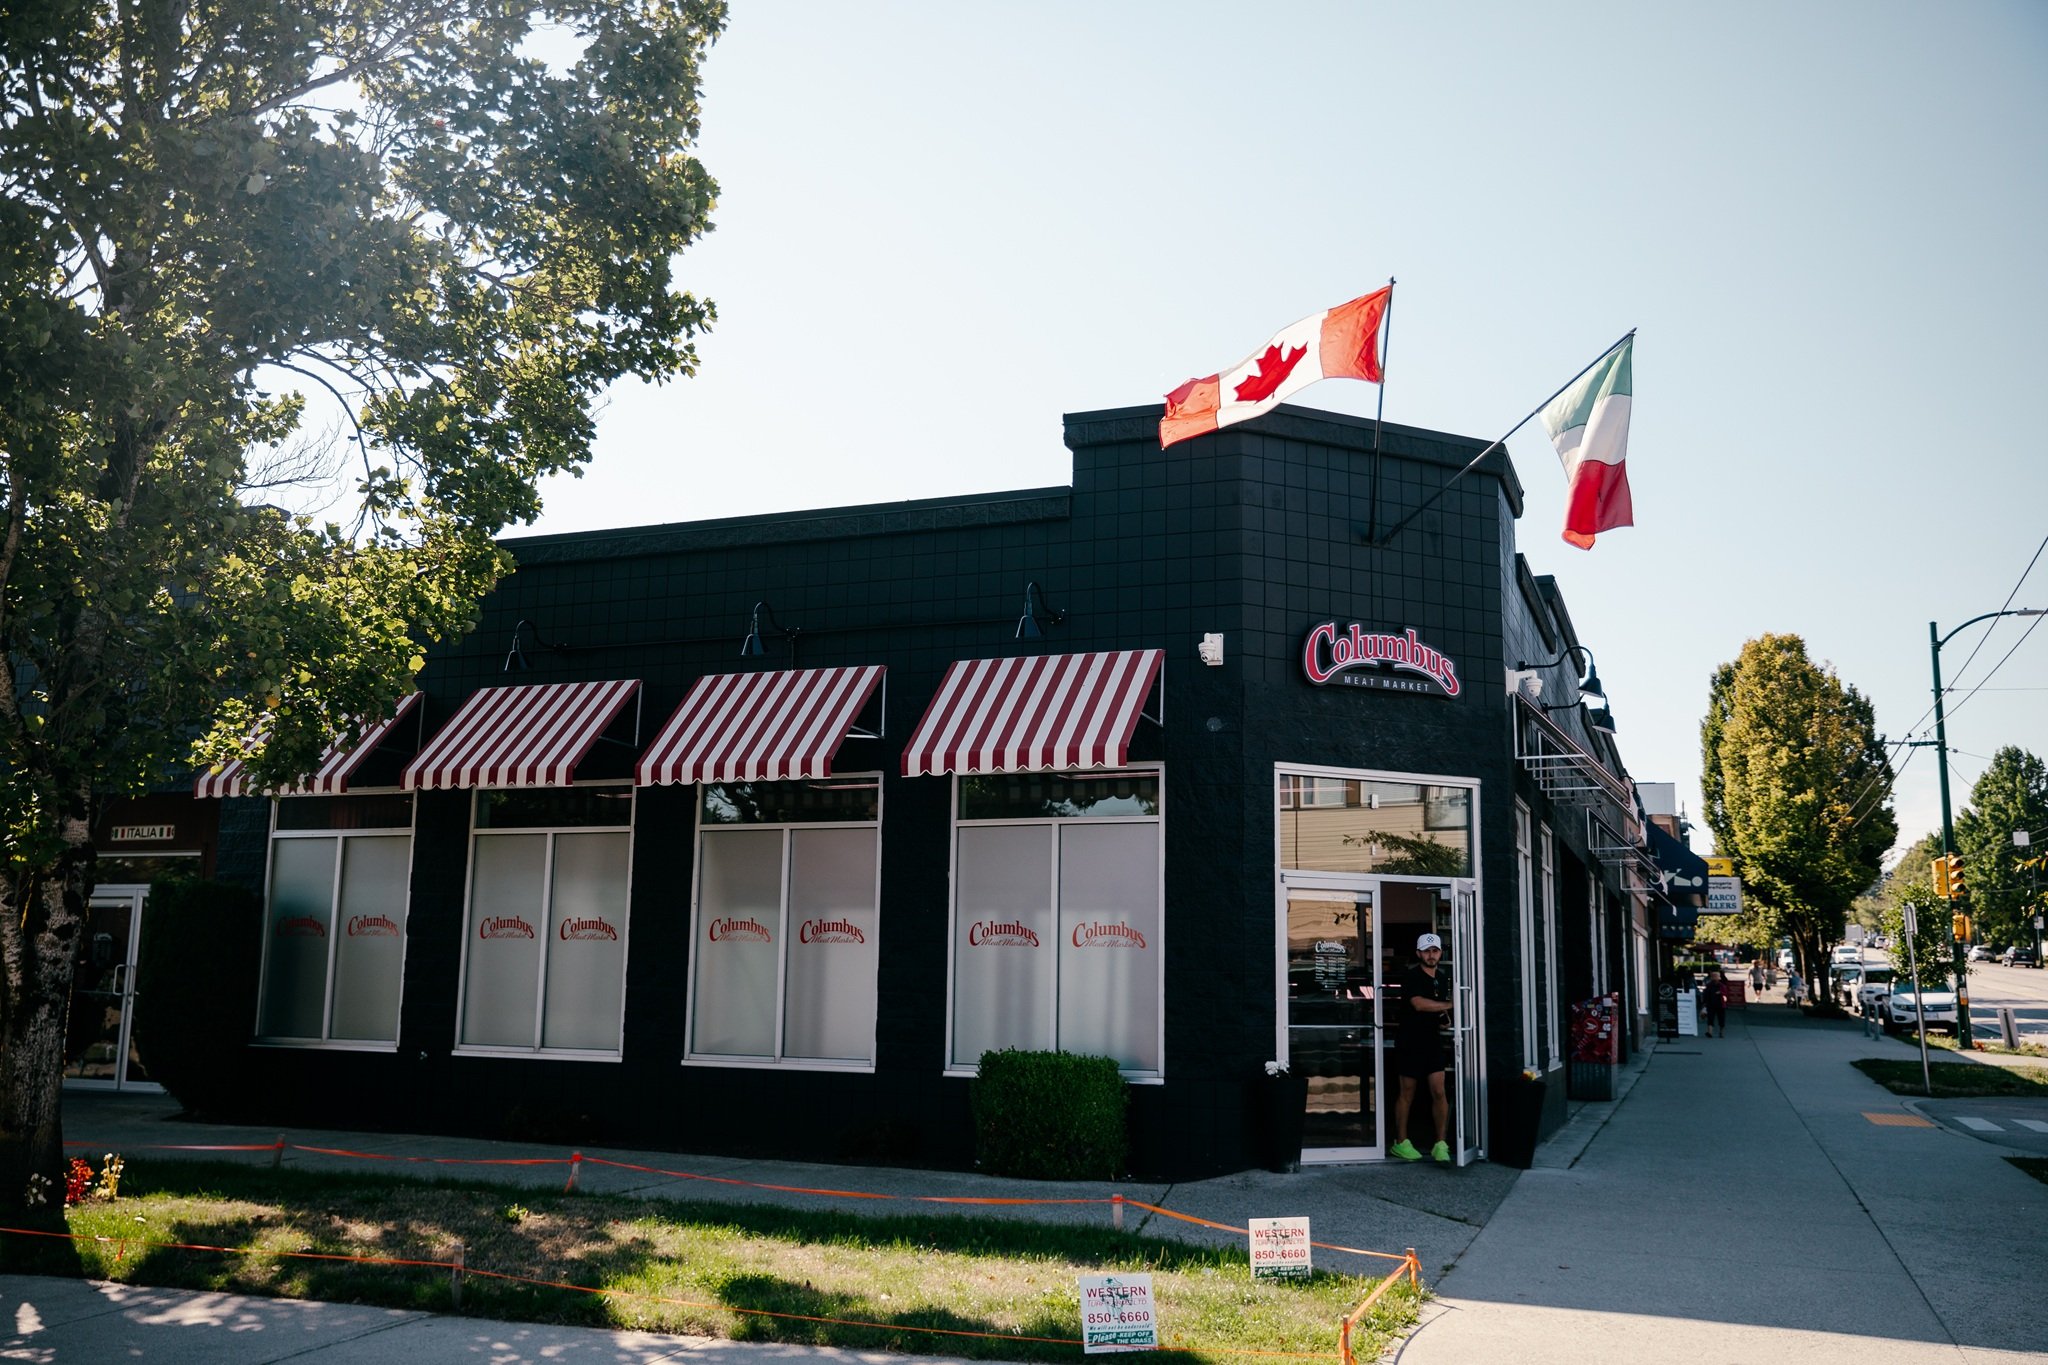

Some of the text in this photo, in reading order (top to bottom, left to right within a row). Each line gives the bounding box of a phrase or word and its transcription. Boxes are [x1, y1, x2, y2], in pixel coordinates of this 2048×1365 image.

[1305, 622, 1460, 696] Columbus
[1344, 675, 1429, 692] MEAT MARKET
[127, 827, 156, 838] ITALIA
[348, 914, 399, 937] Columbus
[480, 915, 535, 940] Columbus
[560, 916, 617, 941] Columbus
[709, 917, 771, 943] Columbus
[799, 918, 865, 944] Columbus
[969, 920, 1040, 948] Columbus
[980, 938, 1030, 947] Meat Market
[1072, 921, 1146, 949] Columbus
[1083, 939, 1137, 948] Meat Market
[1254, 1228, 1305, 1238] WESTERN
[1255, 1249, 1306, 1260] 850-6660
[1086, 1286, 1147, 1298] WESTERN
[1087, 1311, 1150, 1324] 850-6660
[1092, 1332, 1117, 1344] Please
